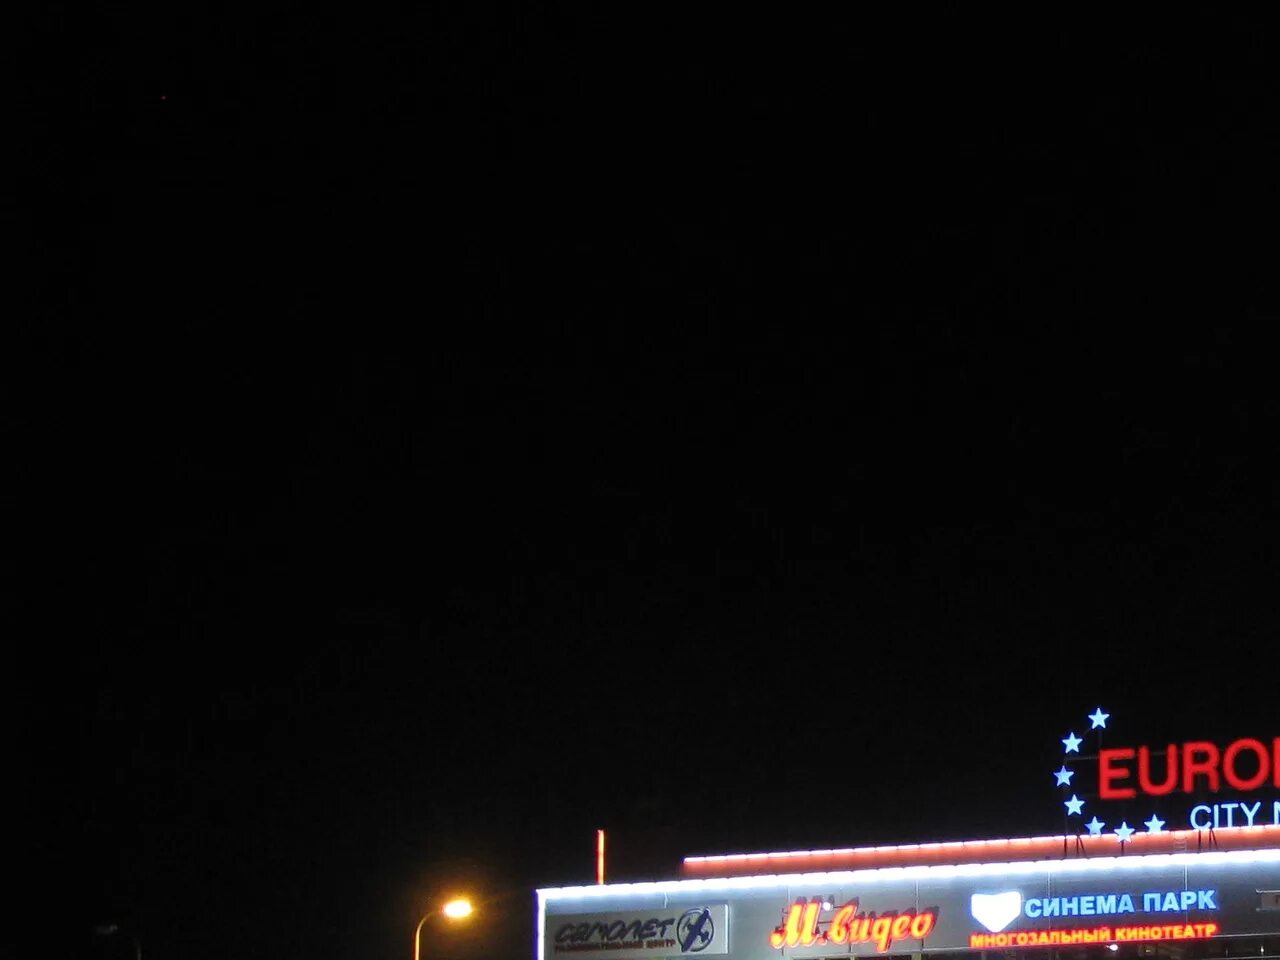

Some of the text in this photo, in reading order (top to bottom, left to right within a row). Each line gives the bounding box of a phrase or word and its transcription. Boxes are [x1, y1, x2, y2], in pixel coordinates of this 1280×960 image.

[1189, 801, 1261, 830] CITY
[1024, 889, 1217, 918] СИНЕМА ПАРК
[970, 923, 1217, 948] МНОГОЗАЛЬНЫЙ КИНОТЕАТР
